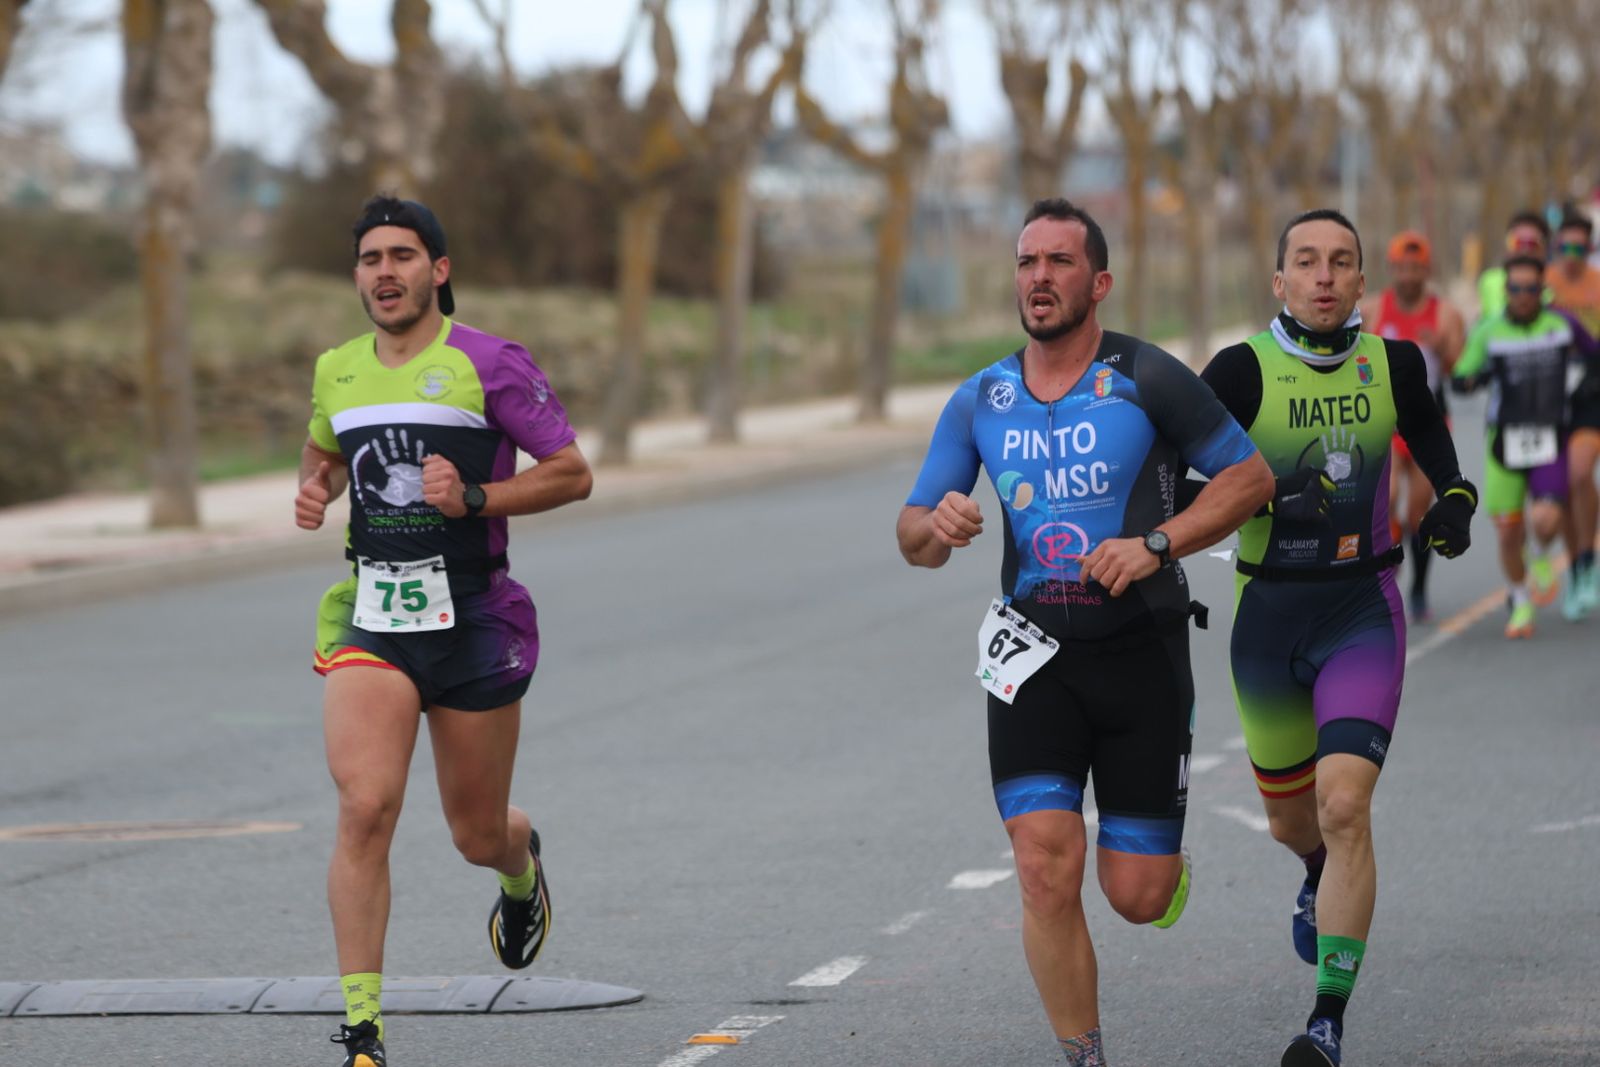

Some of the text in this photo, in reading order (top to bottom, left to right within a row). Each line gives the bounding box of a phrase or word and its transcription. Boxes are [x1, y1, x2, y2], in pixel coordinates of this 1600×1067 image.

[1289, 392, 1371, 429] MATEO
[1002, 421, 1096, 460] PINTO
[1044, 461, 1109, 500] MSC
[1278, 539, 1319, 550] VILLAMAYOR
[375, 579, 428, 613] 75
[988, 628, 1032, 665] 67
